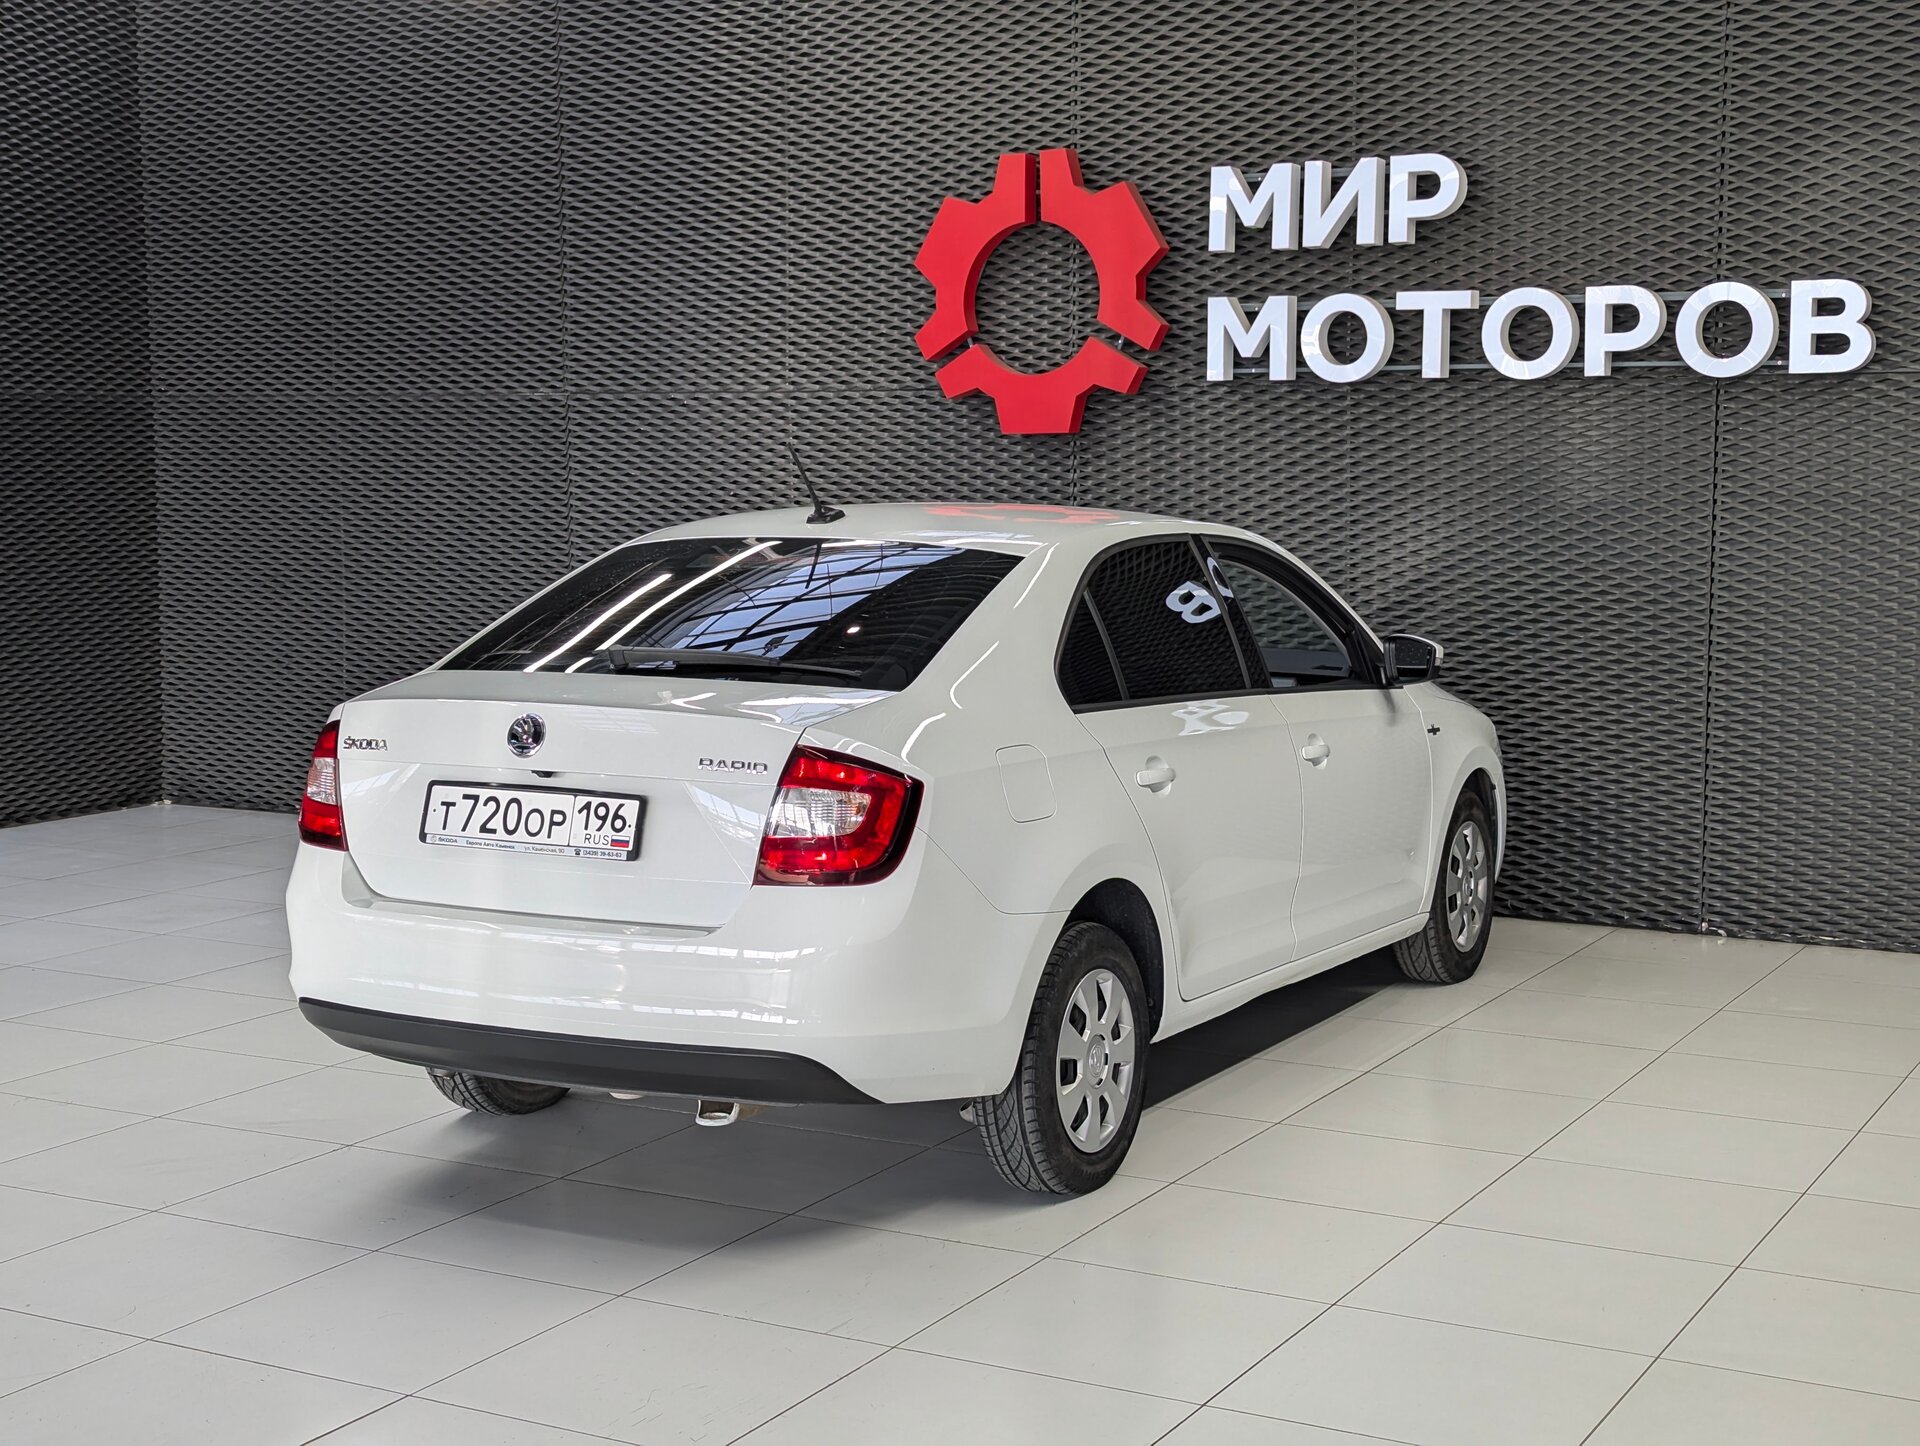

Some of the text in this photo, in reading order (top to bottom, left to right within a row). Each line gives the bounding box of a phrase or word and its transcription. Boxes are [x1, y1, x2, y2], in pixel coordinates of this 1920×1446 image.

[1208, 153, 1467, 252] МИР
[1206, 279, 1876, 383] МОТОРОВ
[698, 757, 768, 775] RAPID
[577, 800, 628, 833] 196
[584, 833, 609, 846] RUS
